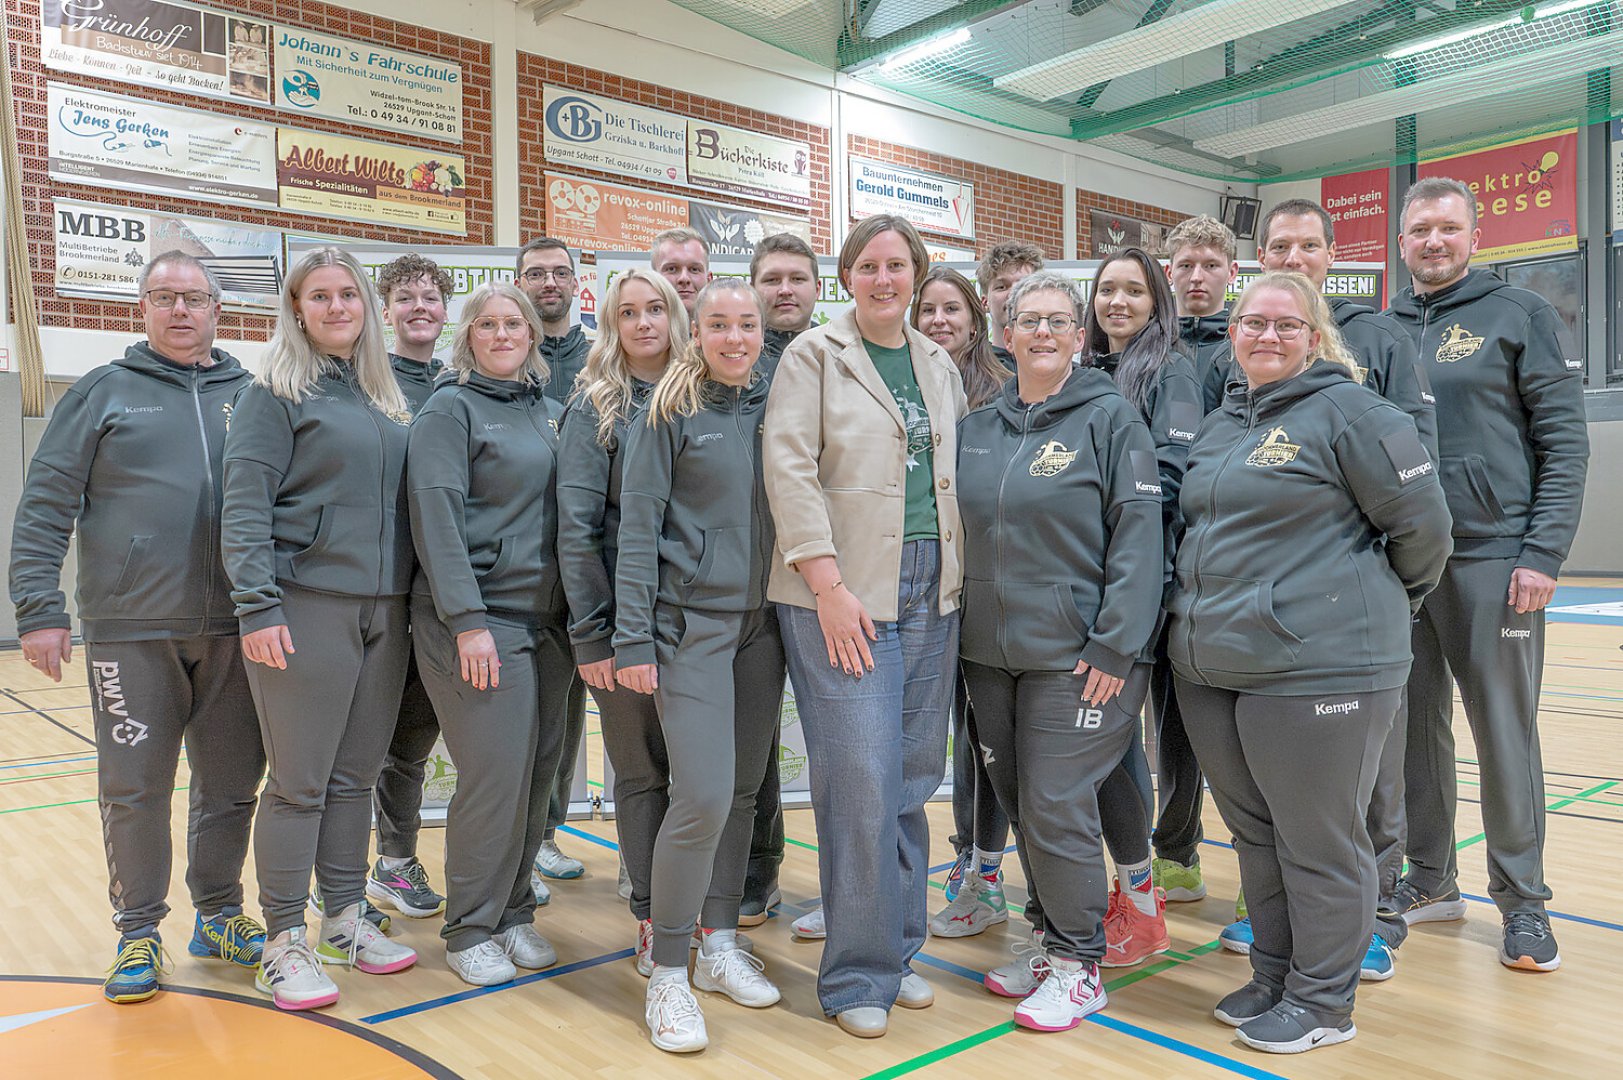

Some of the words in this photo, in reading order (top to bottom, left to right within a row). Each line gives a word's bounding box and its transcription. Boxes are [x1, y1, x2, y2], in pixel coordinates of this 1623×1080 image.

[61, 0, 192, 51] Grünhoff
[296, 55, 313, 67] Mit
[315, 59, 367, 78] Sicherheit
[369, 73, 390, 83] zum
[392, 75, 443, 94] Vergnügen
[368, 52, 458, 83] Fahrschule
[64, 97, 137, 118] Elektromeister
[383, 102, 405, 111] 26529
[73, 109, 110, 129] Jens
[115, 118, 170, 138] Gerken
[347, 105, 368, 117] Tel.:
[370, 109, 378, 119] 0
[381, 111, 394, 121] 49
[396, 114, 409, 124] 34
[418, 118, 429, 129] 91
[431, 120, 445, 131] 08
[447, 123, 456, 133] 81
[604, 113, 625, 129] Die
[628, 117, 685, 141] Tischlerei
[604, 131, 637, 146] Grziska
[649, 141, 684, 156] Barkhoff
[695, 128, 789, 174] Bücherkiste
[284, 144, 350, 176] Albert
[354, 155, 406, 187] Wilts
[547, 145, 575, 158] Upgant
[576, 151, 599, 163] Schott
[605, 156, 615, 166] Tel.
[617, 161, 638, 171] 04934
[290, 176, 314, 187] Frische
[315, 179, 369, 195] Spezialitäten
[862, 166, 944, 193] Bauunternehmen
[1471, 169, 1542, 195] ektro
[378, 190, 392, 199] aus
[394, 192, 408, 201] dem
[409, 194, 462, 209] Brookmerland
[603, 192, 687, 217] revox-online
[856, 179, 894, 198] Gerold
[897, 187, 949, 209] Gummels
[1326, 194, 1357, 209] Dabei
[1359, 190, 1382, 203] sein
[1476, 188, 1552, 219] eese
[1343, 204, 1385, 221] einfach.
[58, 210, 146, 243] MBB
[621, 222, 640, 231] 26529
[59, 240, 118, 255] MultiBetriebe
[59, 249, 120, 264] Brookmerland
[77, 270, 116, 282] 0151-281
[119, 275, 134, 284] 586
[1322, 276, 1374, 294] ISSEN!
[124, 405, 163, 414] Kempa
[697, 432, 724, 442] empa
[1169, 428, 1195, 440] Kemp
[1398, 461, 1432, 481] Kempa
[1501, 627, 1531, 640] Kempa
[1074, 708, 1104, 729] IB
[1315, 700, 1360, 716] Kempa
